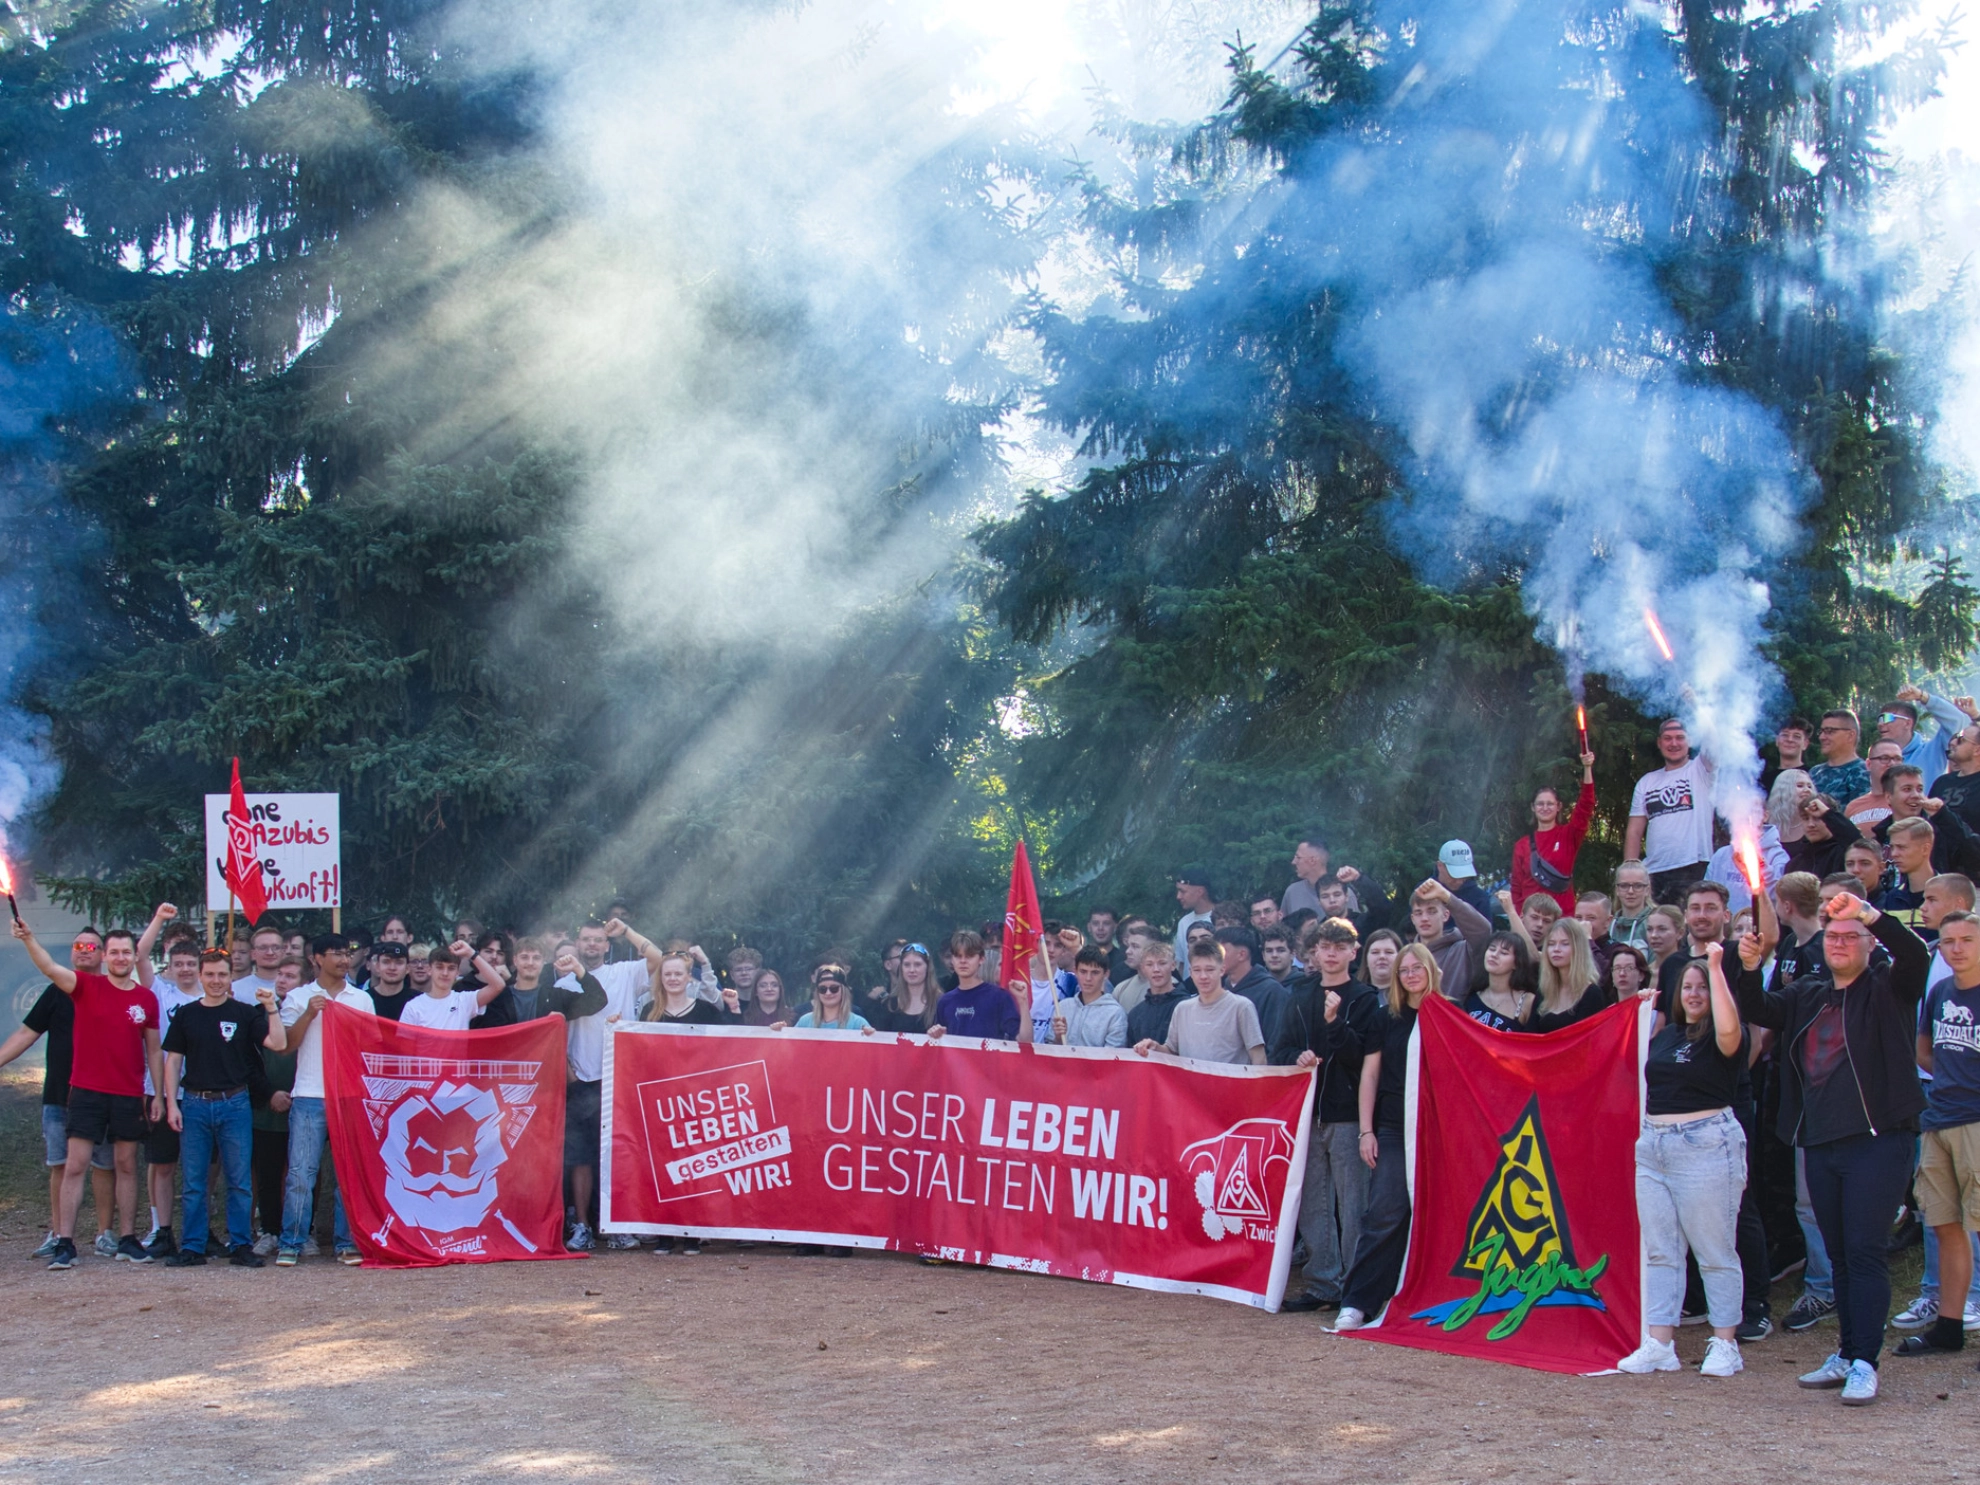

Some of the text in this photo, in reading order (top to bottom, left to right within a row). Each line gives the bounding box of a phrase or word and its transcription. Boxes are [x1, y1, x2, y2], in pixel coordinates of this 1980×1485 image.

[263, 863, 338, 906] ukunft!
[656, 1083, 753, 1122] UNSER
[825, 1086, 1120, 1160] UNSER LEBEN
[668, 1109, 759, 1149] LEBEN
[678, 1132, 782, 1181] gestalten
[724, 1161, 792, 1196] WIR!
[822, 1143, 1169, 1231] GESTALTEN WIR!
[1248, 1222, 1279, 1243] Zwic
